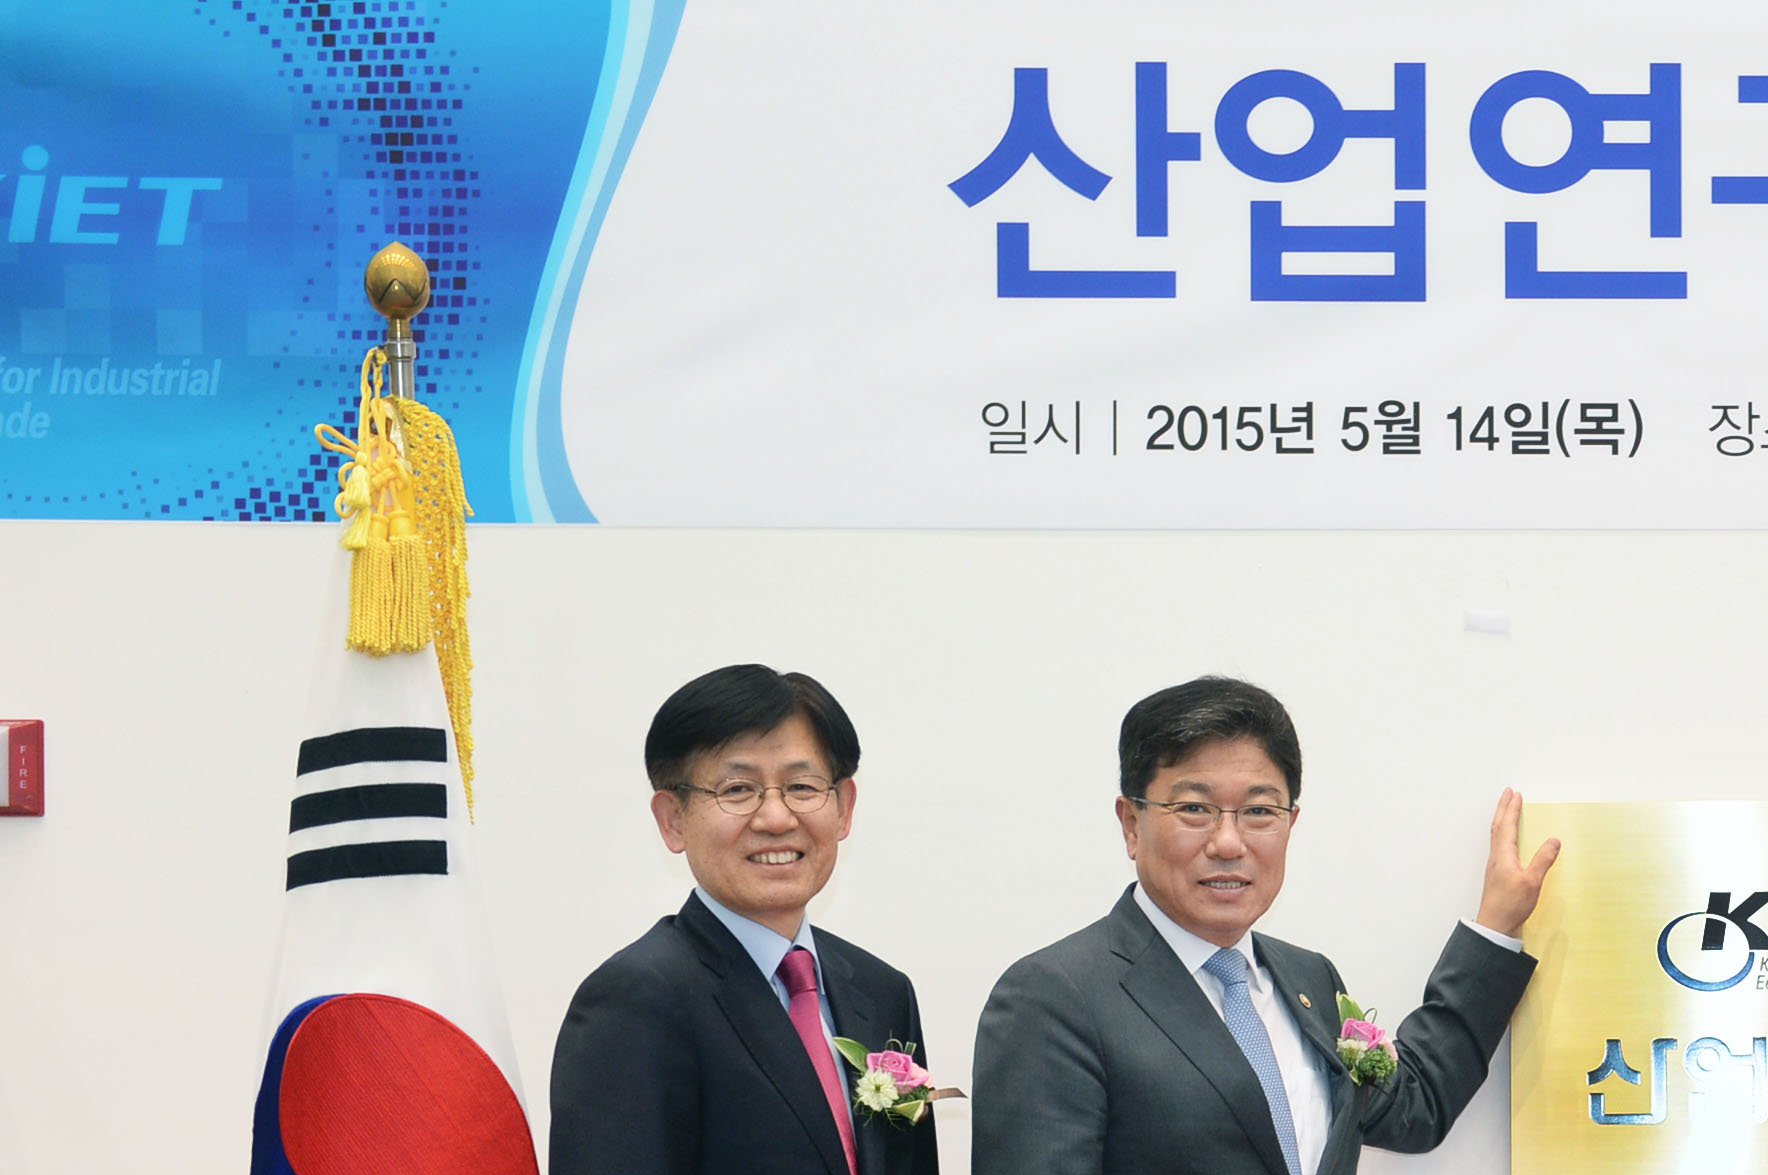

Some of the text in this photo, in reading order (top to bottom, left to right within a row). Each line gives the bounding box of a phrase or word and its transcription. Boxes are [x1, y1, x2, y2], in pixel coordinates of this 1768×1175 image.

[50, 356, 222, 397] Industrial
[981, 400, 1081, 455] 일시
[1145, 401, 1315, 455] 2015년
[1340, 400, 1422, 455] 5월
[1446, 398, 1645, 458] 14일(목)
[19, 744, 28, 790] FIRE
